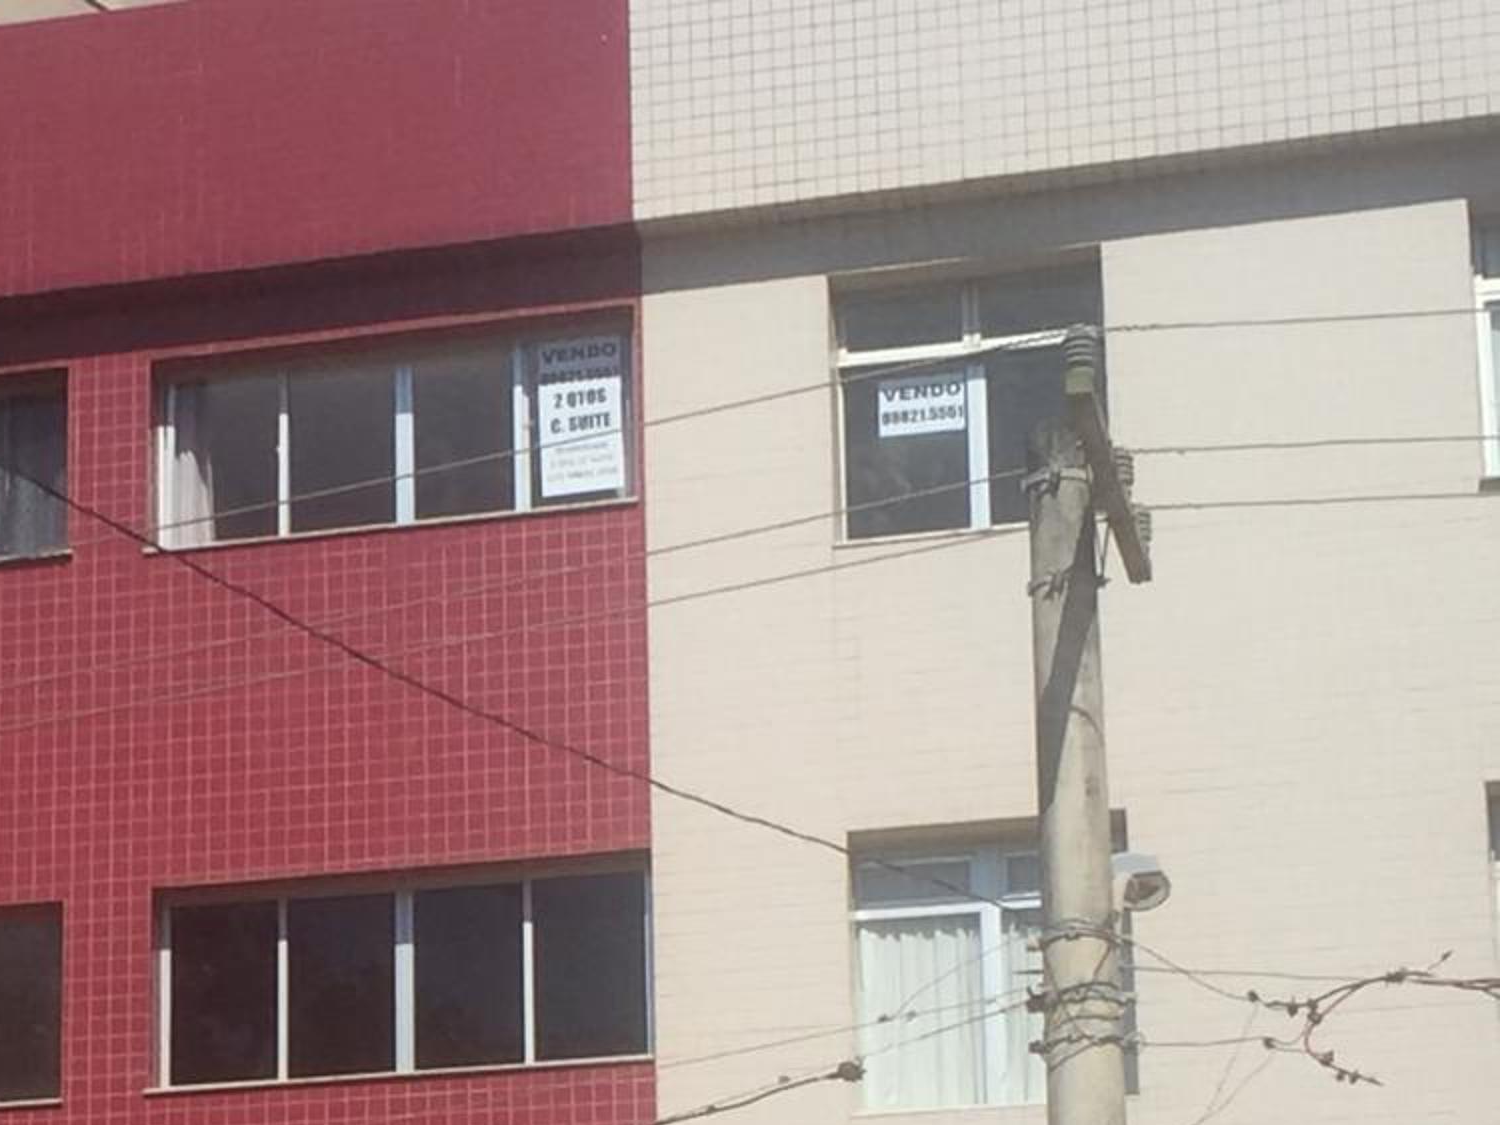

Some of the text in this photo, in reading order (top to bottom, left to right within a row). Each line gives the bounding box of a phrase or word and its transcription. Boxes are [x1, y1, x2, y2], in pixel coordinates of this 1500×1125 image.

[542, 342, 617, 364] VENDO
[553, 393, 563, 409] 2
[882, 381, 961, 402] VENDO
